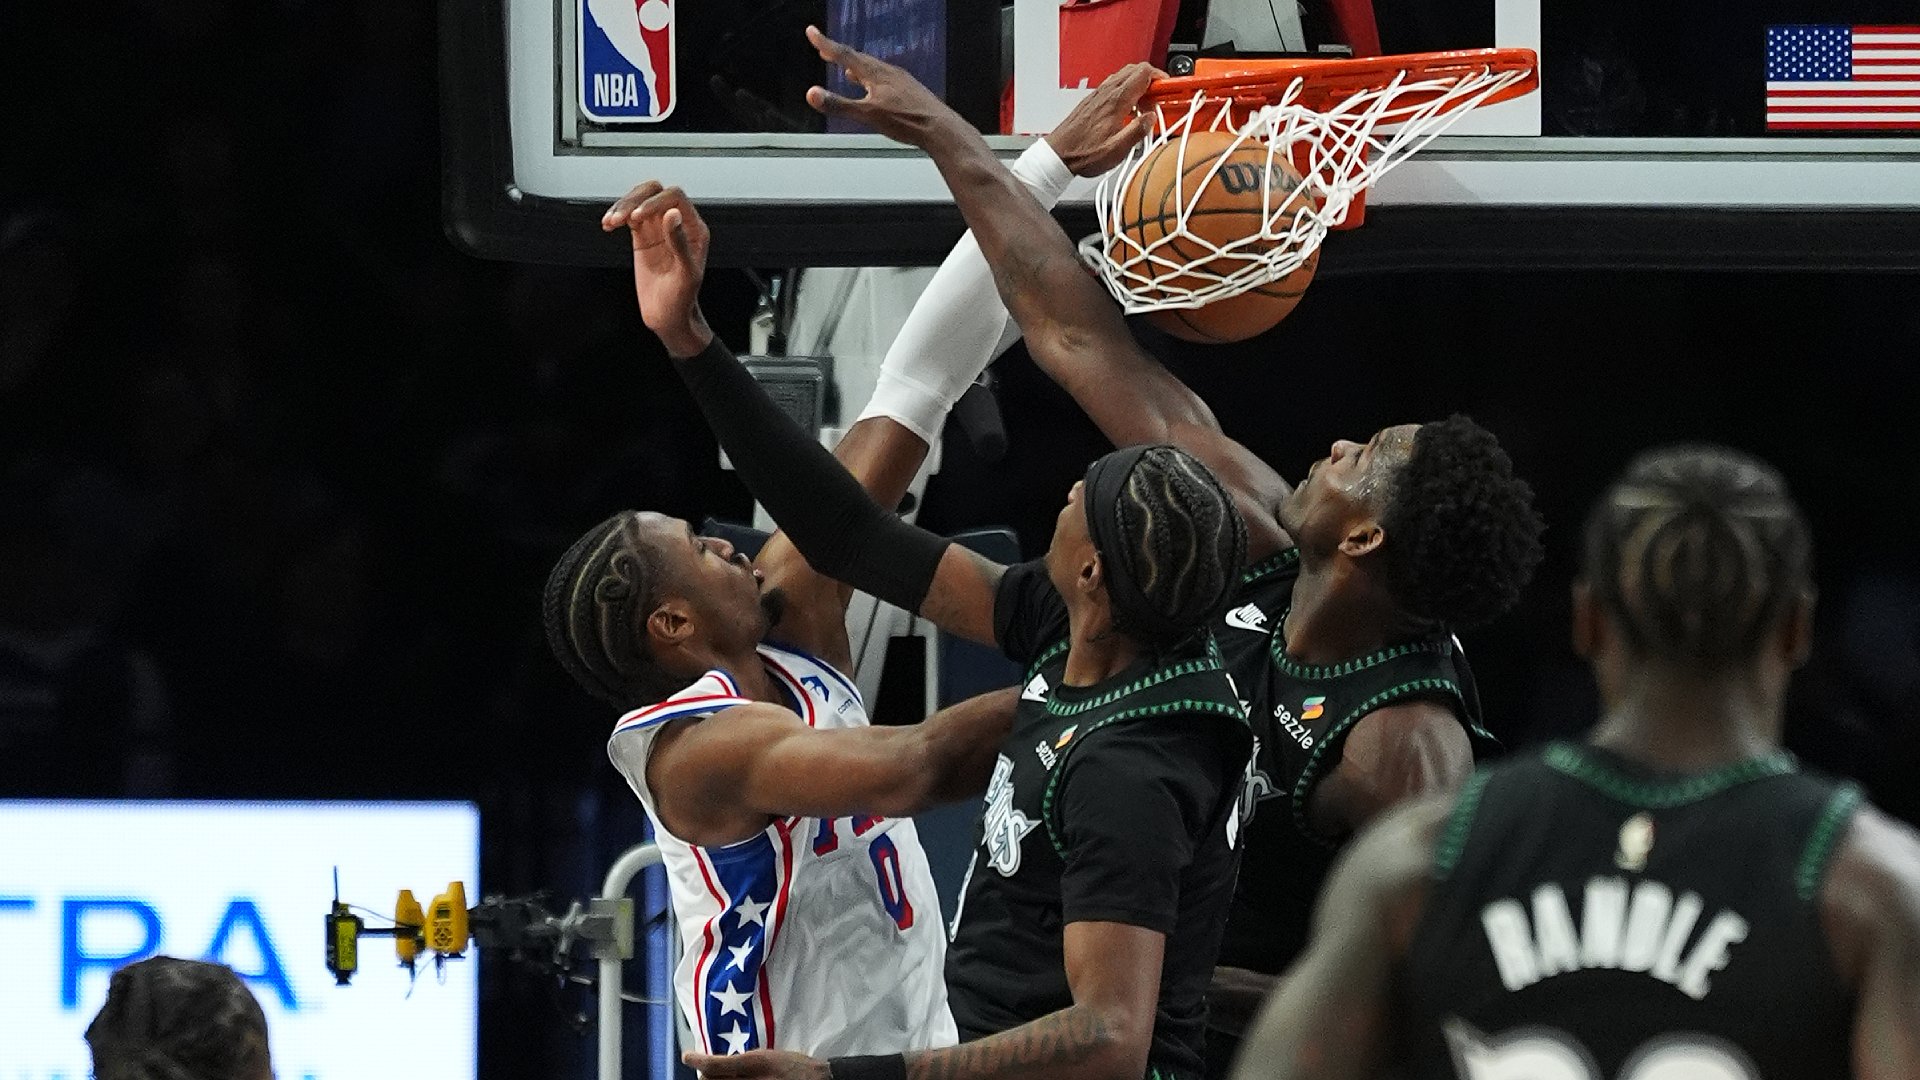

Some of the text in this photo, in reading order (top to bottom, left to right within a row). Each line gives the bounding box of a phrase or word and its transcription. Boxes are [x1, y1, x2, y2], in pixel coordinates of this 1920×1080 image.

[594, 73, 639, 107] NBA
[1273, 704, 1314, 750] sezzle
[868, 832, 914, 931] 0
[1482, 876, 1750, 999] RANDLE
